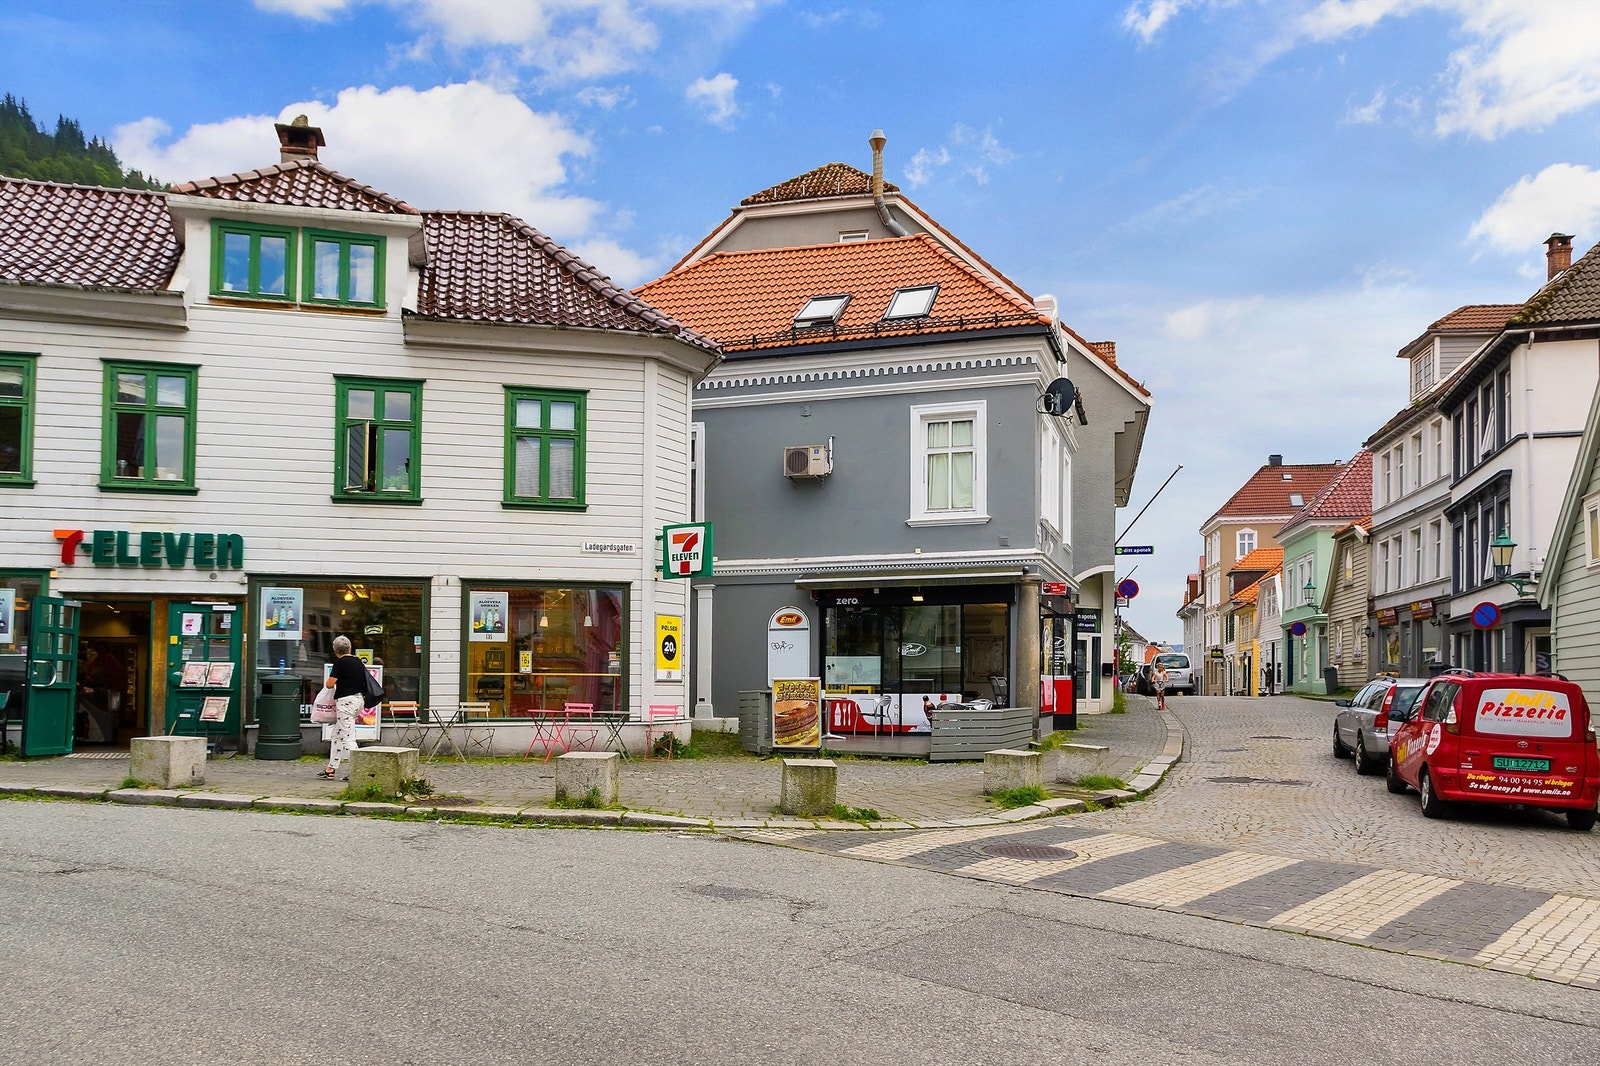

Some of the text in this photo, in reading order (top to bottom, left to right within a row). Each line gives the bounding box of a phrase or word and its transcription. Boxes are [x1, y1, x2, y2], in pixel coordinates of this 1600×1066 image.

[672, 532, 699, 574] 7
[1505, 690, 1556, 709] Emil's
[1481, 701, 1567, 720] Pizzeria
[1496, 758, 1546, 769] SU 12712
[1475, 774, 1496, 783] ringer
[1551, 779, 1574, 788] bringer
[1479, 782, 1491, 790] vår
[1491, 784, 1511, 794] meny
[1510, 785, 1521, 794] på
[1522, 787, 1572, 796] www.emils.no
